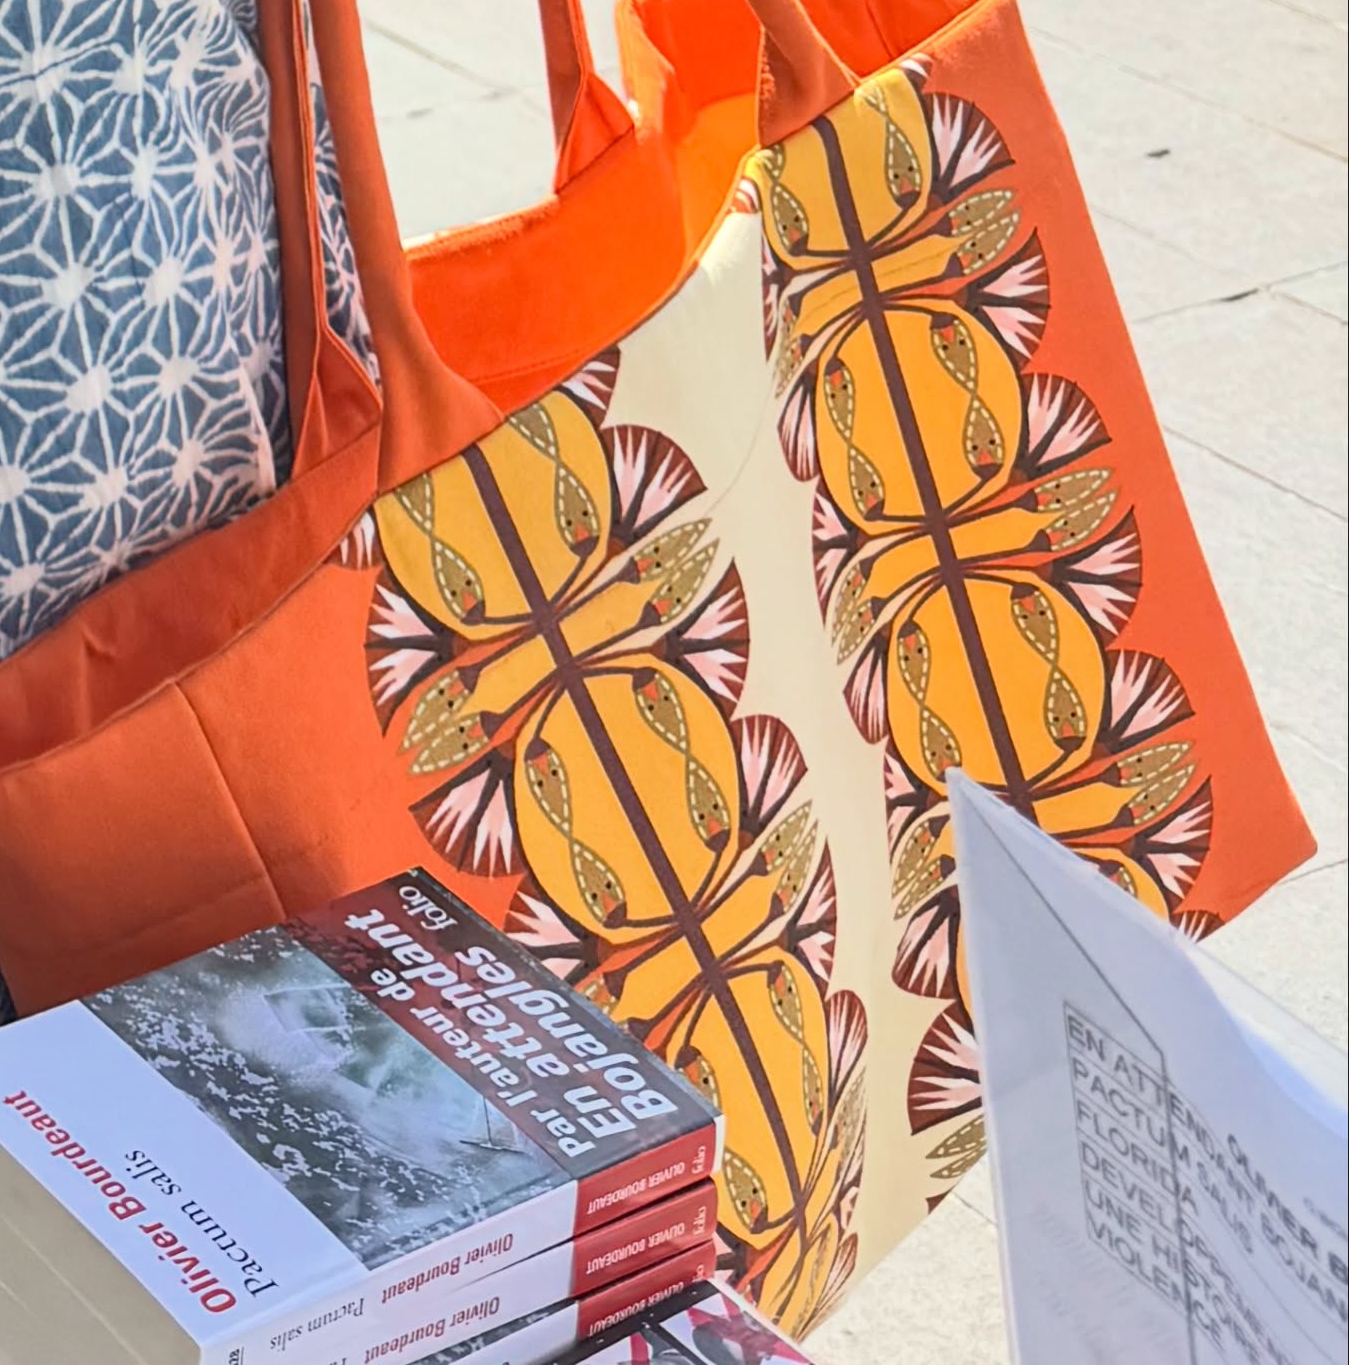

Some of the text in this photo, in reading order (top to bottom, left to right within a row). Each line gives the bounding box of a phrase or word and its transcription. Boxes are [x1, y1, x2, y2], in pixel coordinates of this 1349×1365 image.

[399, 885, 458, 930] folio
[344, 908, 637, 1138] En attendant
[370, 968, 596, 1158] Par l'auteur de
[454, 946, 679, 1120] Bojangles
[1067, 1015, 1106, 1061] EN
[2, 1090, 237, 1313] Olivier Bourdeaut
[587, 1162, 685, 1215] OLIVIER BOURDEAUT
[1072, 1057, 1253, 1254] PACTUM SALIS
[1077, 1100, 1200, 1217] FLORIDA
[1085, 1179, 1144, 1245] UNE
[125, 1149, 279, 1298] Pactum salis
[586, 1222, 685, 1275] OLIVIER BOURDEAUT
[1086, 1210, 1225, 1351] VIOLENCE
[269, 1233, 514, 1353] Olivier Bourdeaut Pactum salis
[364, 1296, 500, 1365] Olivier Bourdeaut
